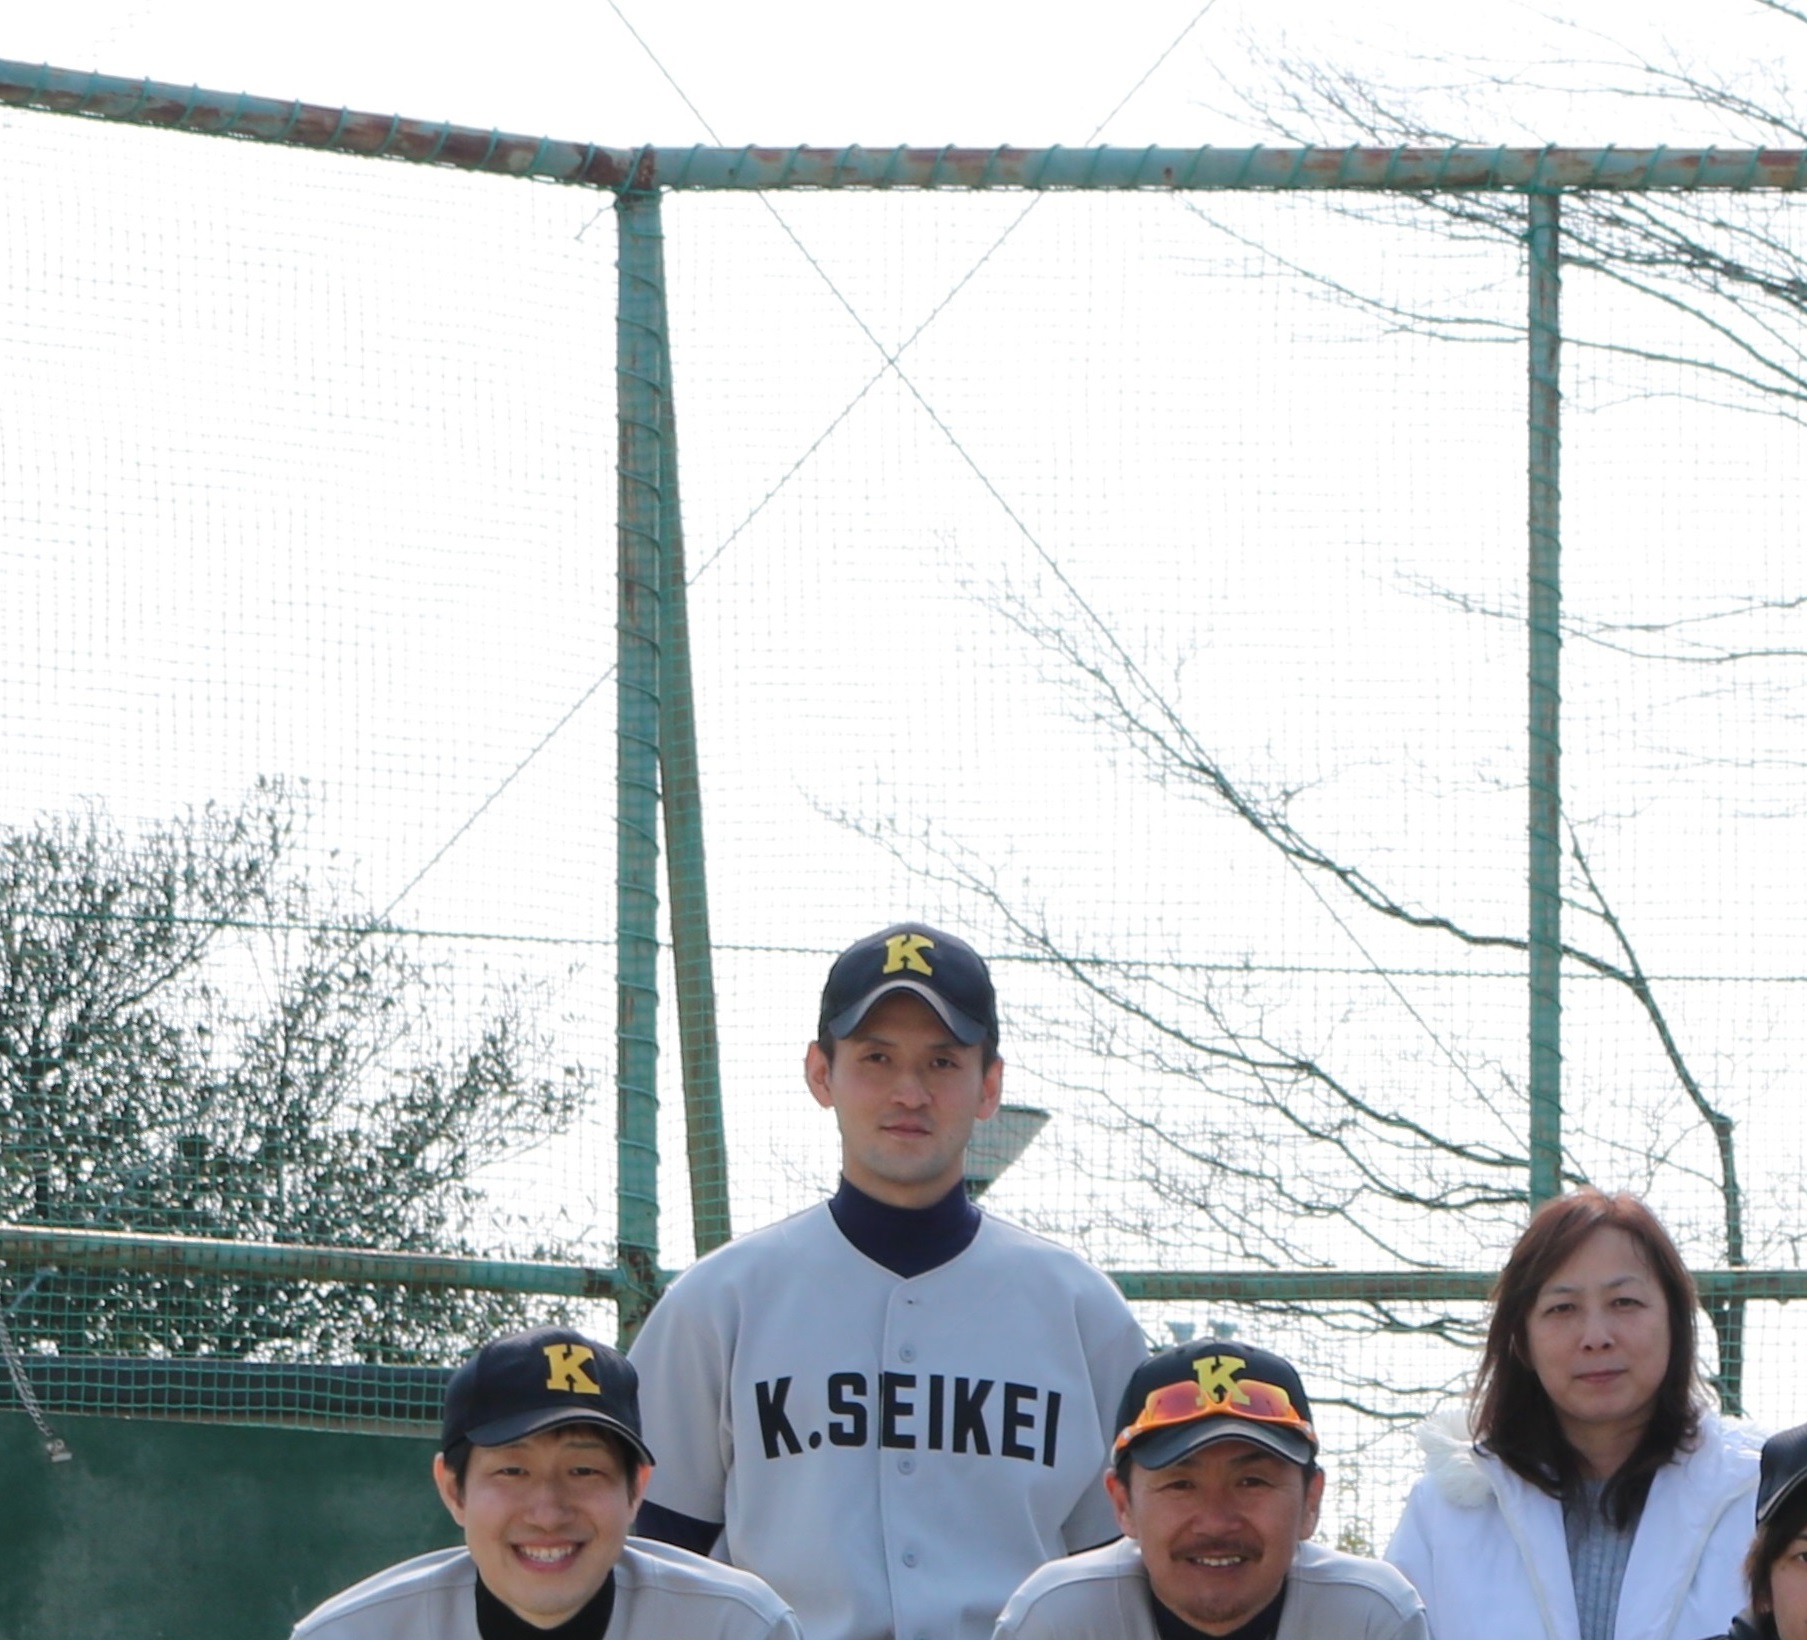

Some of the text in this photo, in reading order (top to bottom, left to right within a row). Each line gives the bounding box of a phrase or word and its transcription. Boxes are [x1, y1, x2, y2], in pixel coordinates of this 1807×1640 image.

[883, 933, 935, 976] K
[543, 1344, 600, 1394] K
[755, 1371, 1062, 1468] K.SEIKEI
